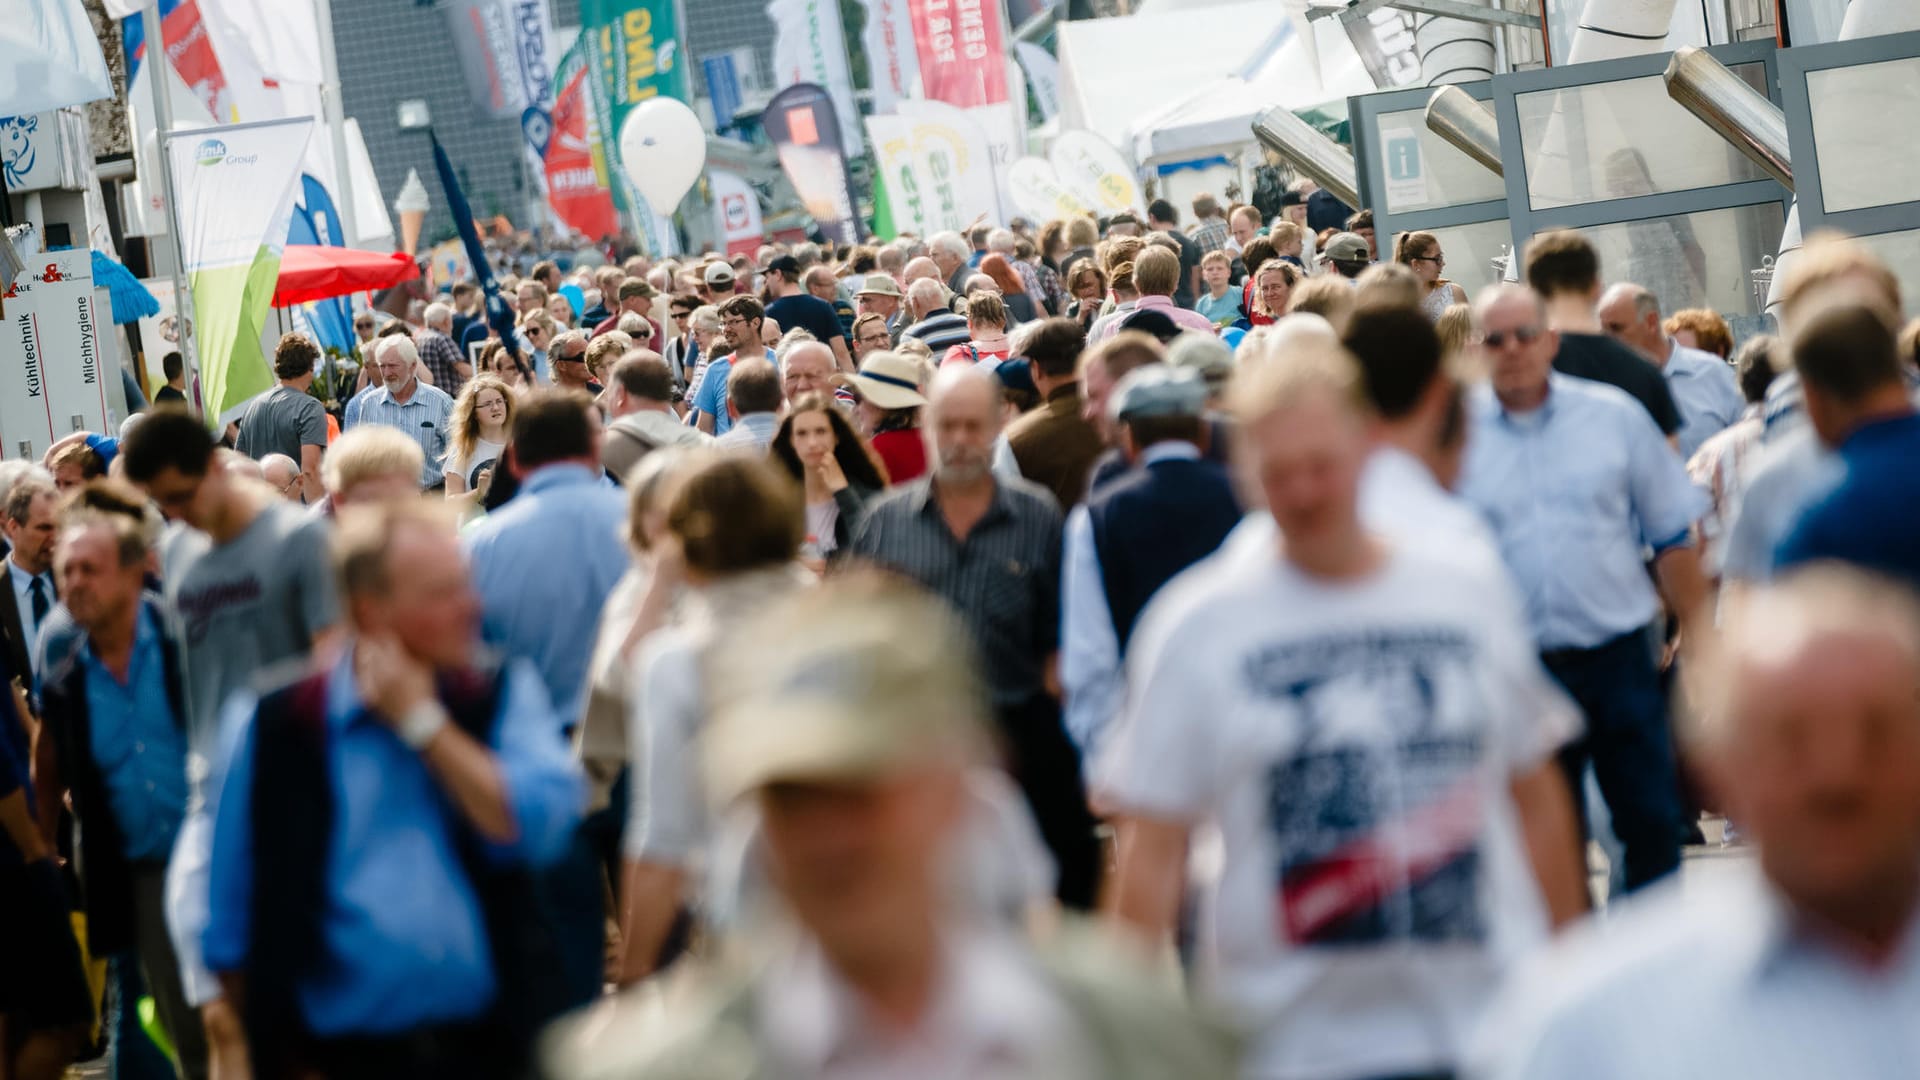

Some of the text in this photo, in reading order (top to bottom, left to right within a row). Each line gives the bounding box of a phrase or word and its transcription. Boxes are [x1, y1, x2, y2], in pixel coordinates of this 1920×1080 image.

[225, 153, 259, 167] Group
[18, 313, 41, 397] Kühltechnik
[77, 296, 95, 384] Milchhygiene
